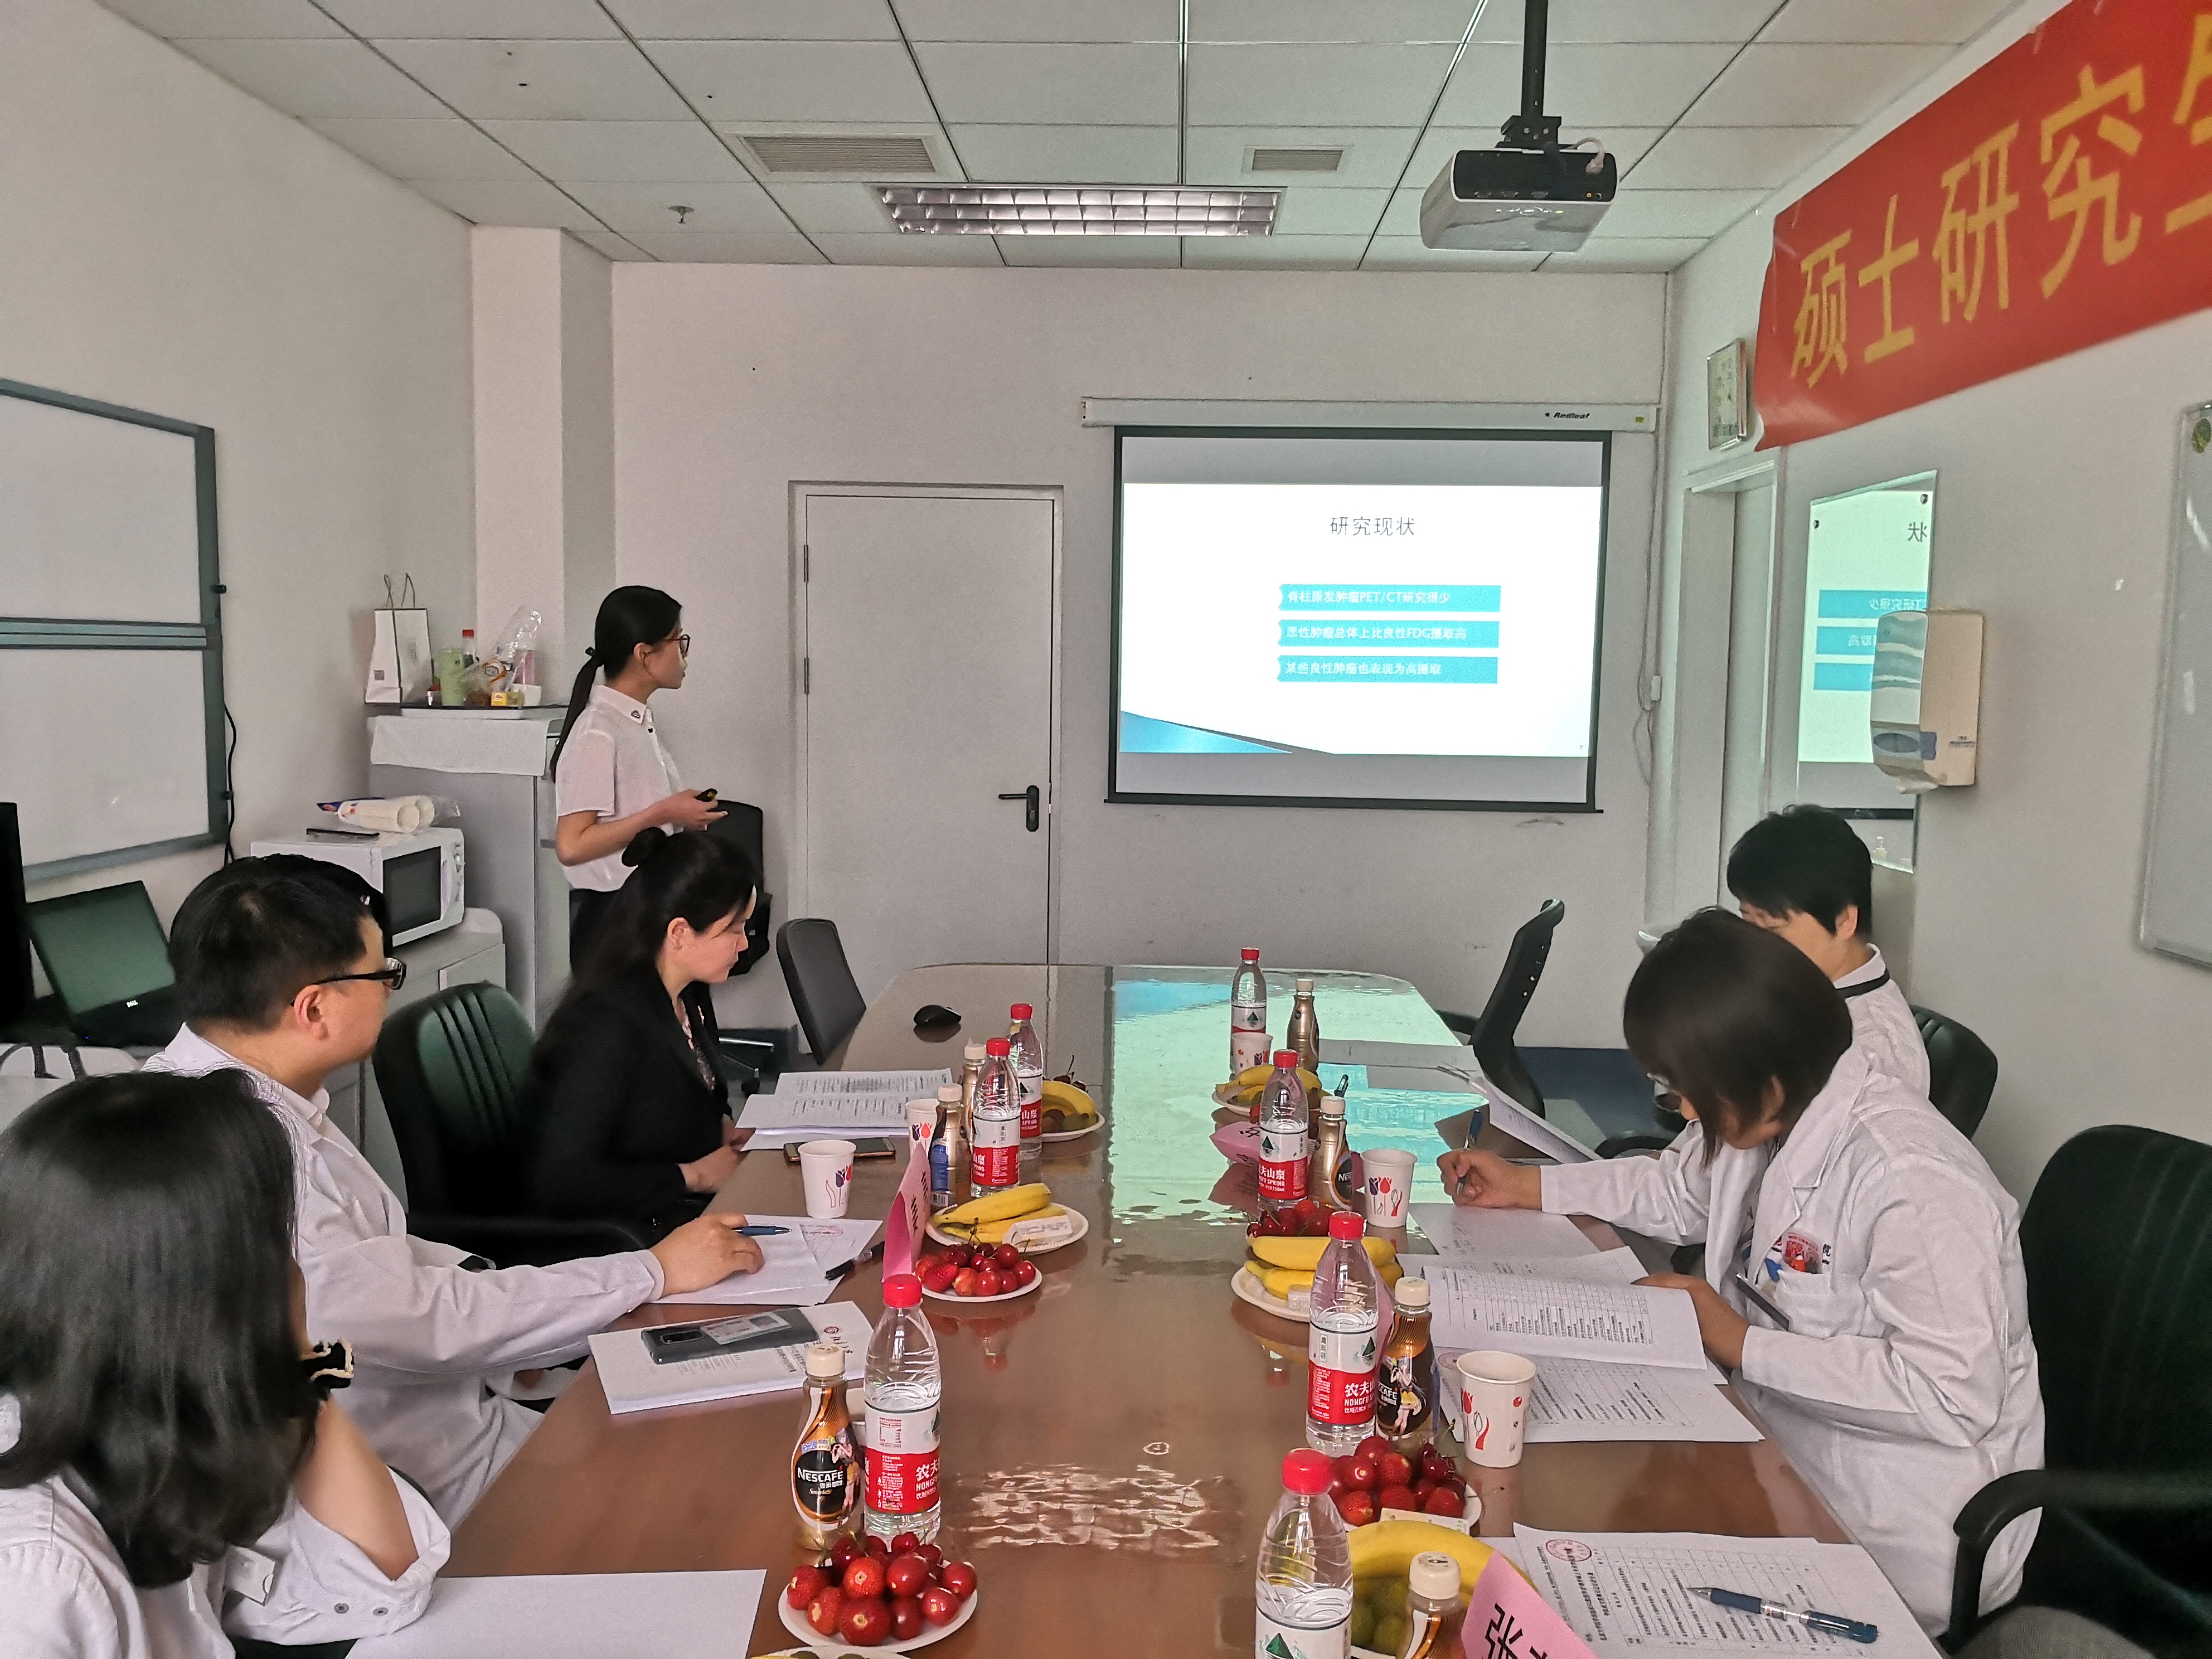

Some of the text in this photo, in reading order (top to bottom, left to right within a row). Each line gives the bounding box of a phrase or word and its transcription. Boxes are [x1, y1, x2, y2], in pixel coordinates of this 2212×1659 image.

[1330, 516, 1415, 536] 研究现状
[1287, 590, 1451, 604] 脊柱原发肿瘤PET/CT研究很少
[1285, 662, 1442, 676] 某些良性肿瘤也表现为高摄取
[126, 999, 138, 1008] DELL
